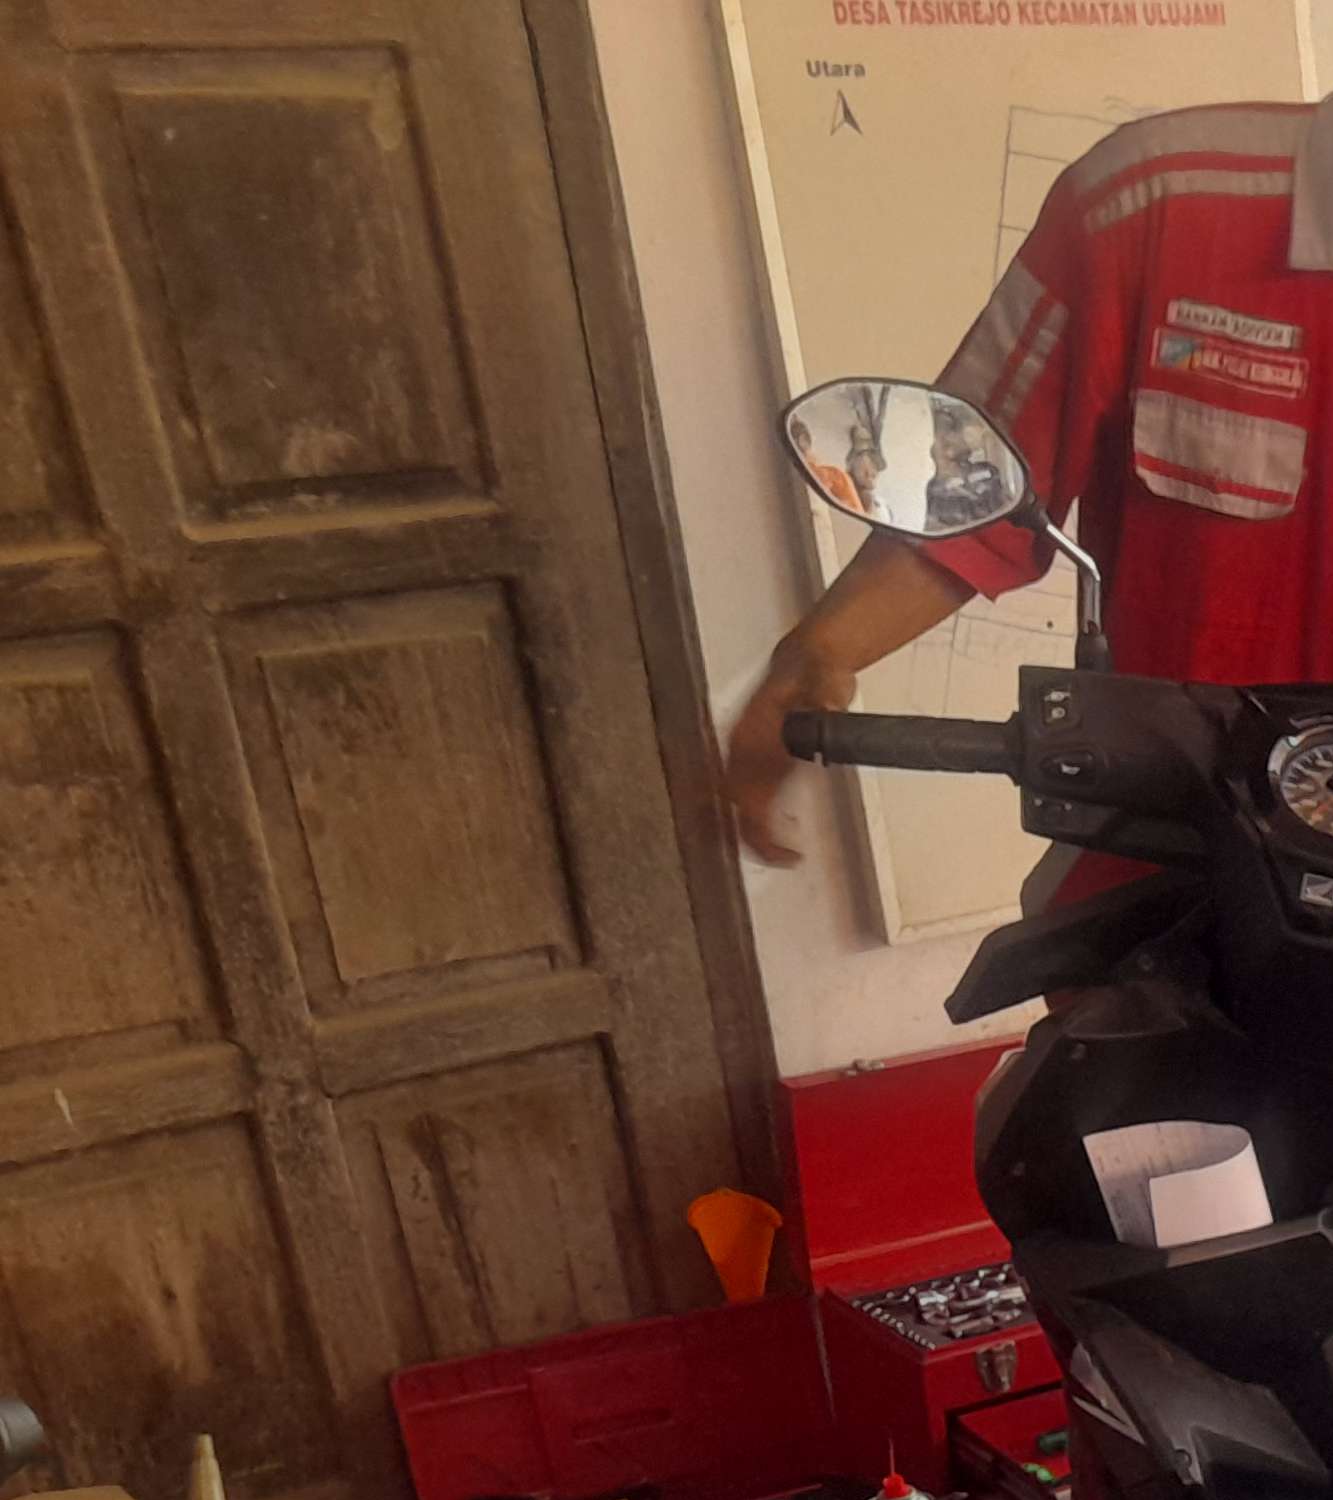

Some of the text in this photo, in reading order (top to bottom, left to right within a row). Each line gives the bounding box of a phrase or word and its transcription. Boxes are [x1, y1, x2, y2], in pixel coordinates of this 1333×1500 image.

[833, 0, 1226, 26] DESA TASIKREJO KECAMATAN ULUJAMI
[806, 60, 866, 79] Utara
